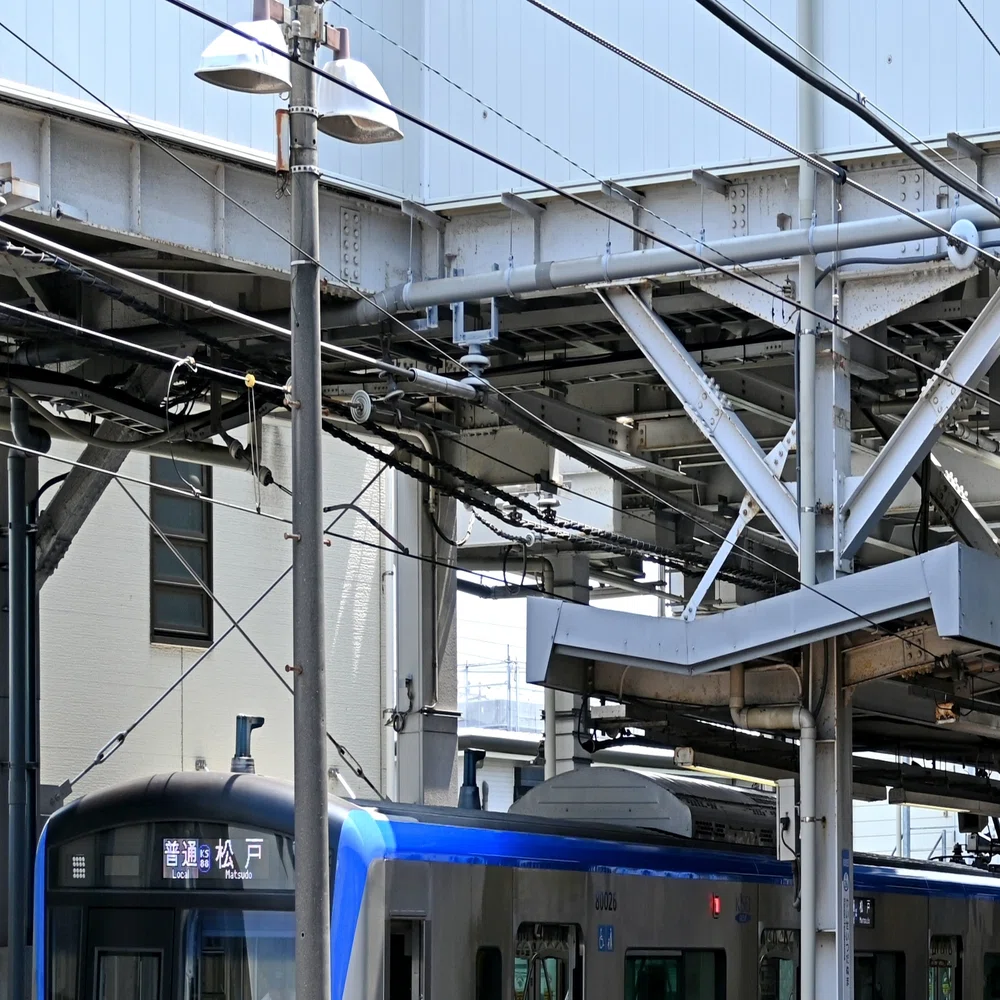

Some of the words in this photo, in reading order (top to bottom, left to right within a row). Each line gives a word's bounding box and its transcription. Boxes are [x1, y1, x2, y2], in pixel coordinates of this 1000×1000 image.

[164, 840, 198, 867] 普通
[215, 838, 264, 870] 松戸
[200, 850, 210, 858] KS
[200, 860, 210, 868] 88
[171, 869, 190, 879] Local
[225, 869, 253, 880] Matsudo
[595, 891, 617, 911] 80026
